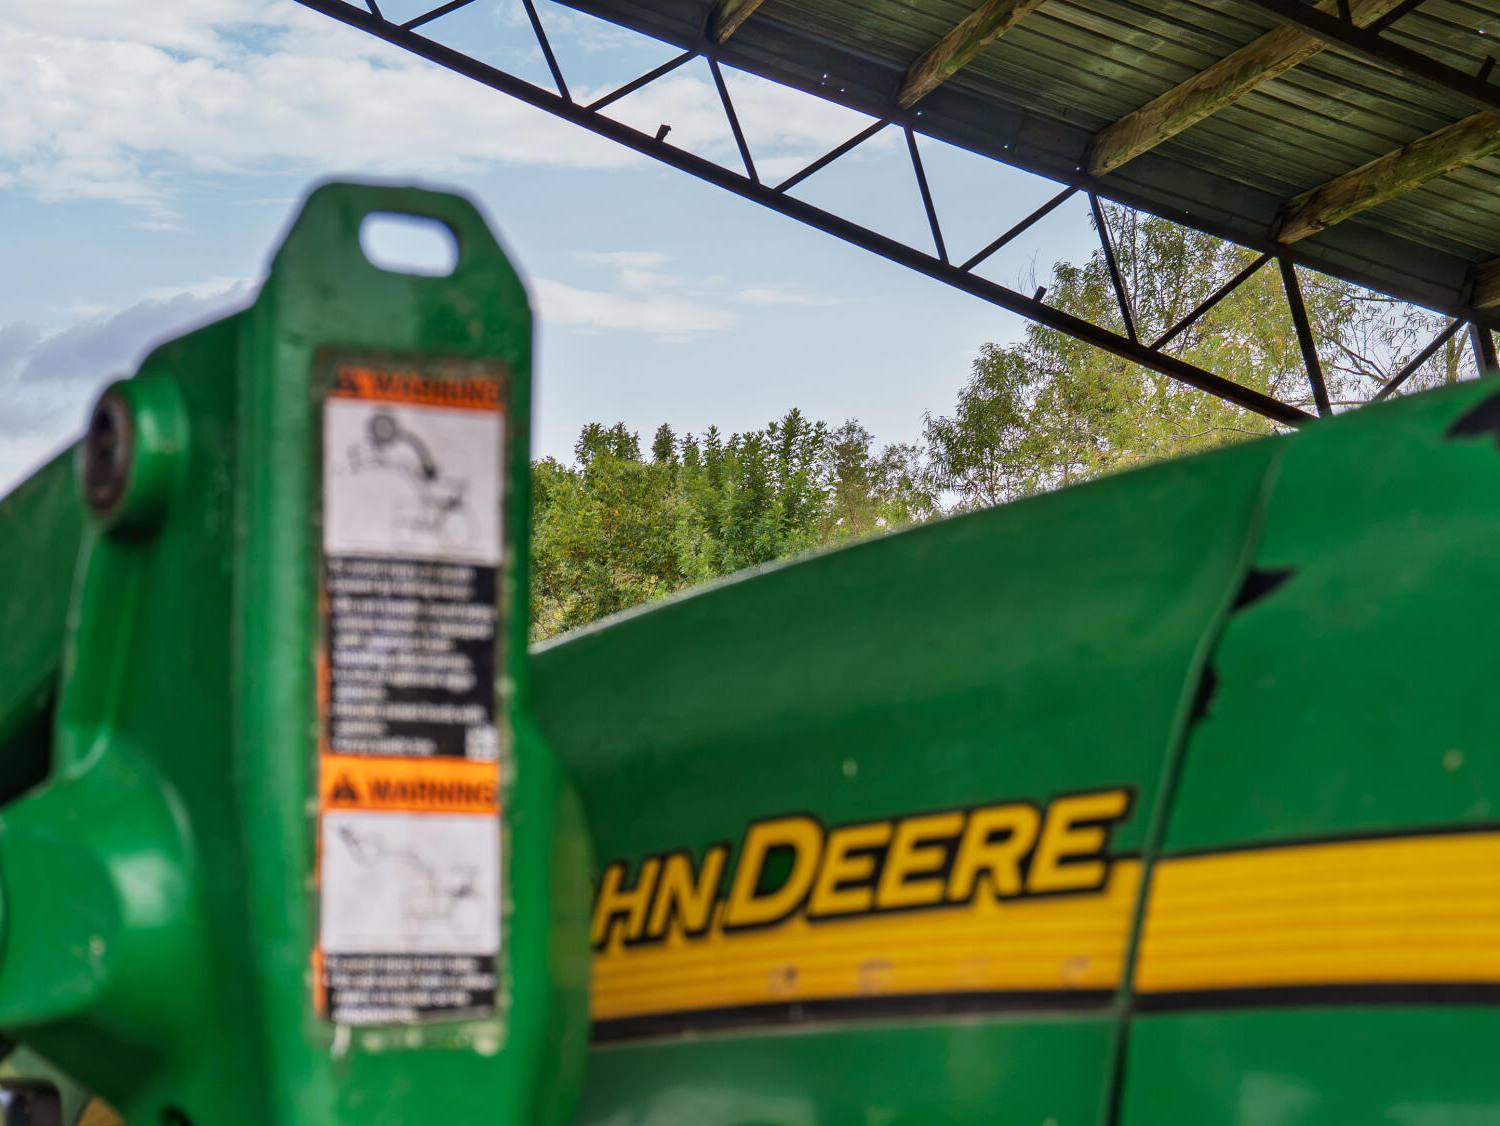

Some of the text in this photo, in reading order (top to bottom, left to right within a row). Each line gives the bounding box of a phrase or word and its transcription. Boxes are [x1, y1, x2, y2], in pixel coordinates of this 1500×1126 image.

[368, 778, 495, 803] WARNING
[590, 787, 1134, 948] HN DEERE
